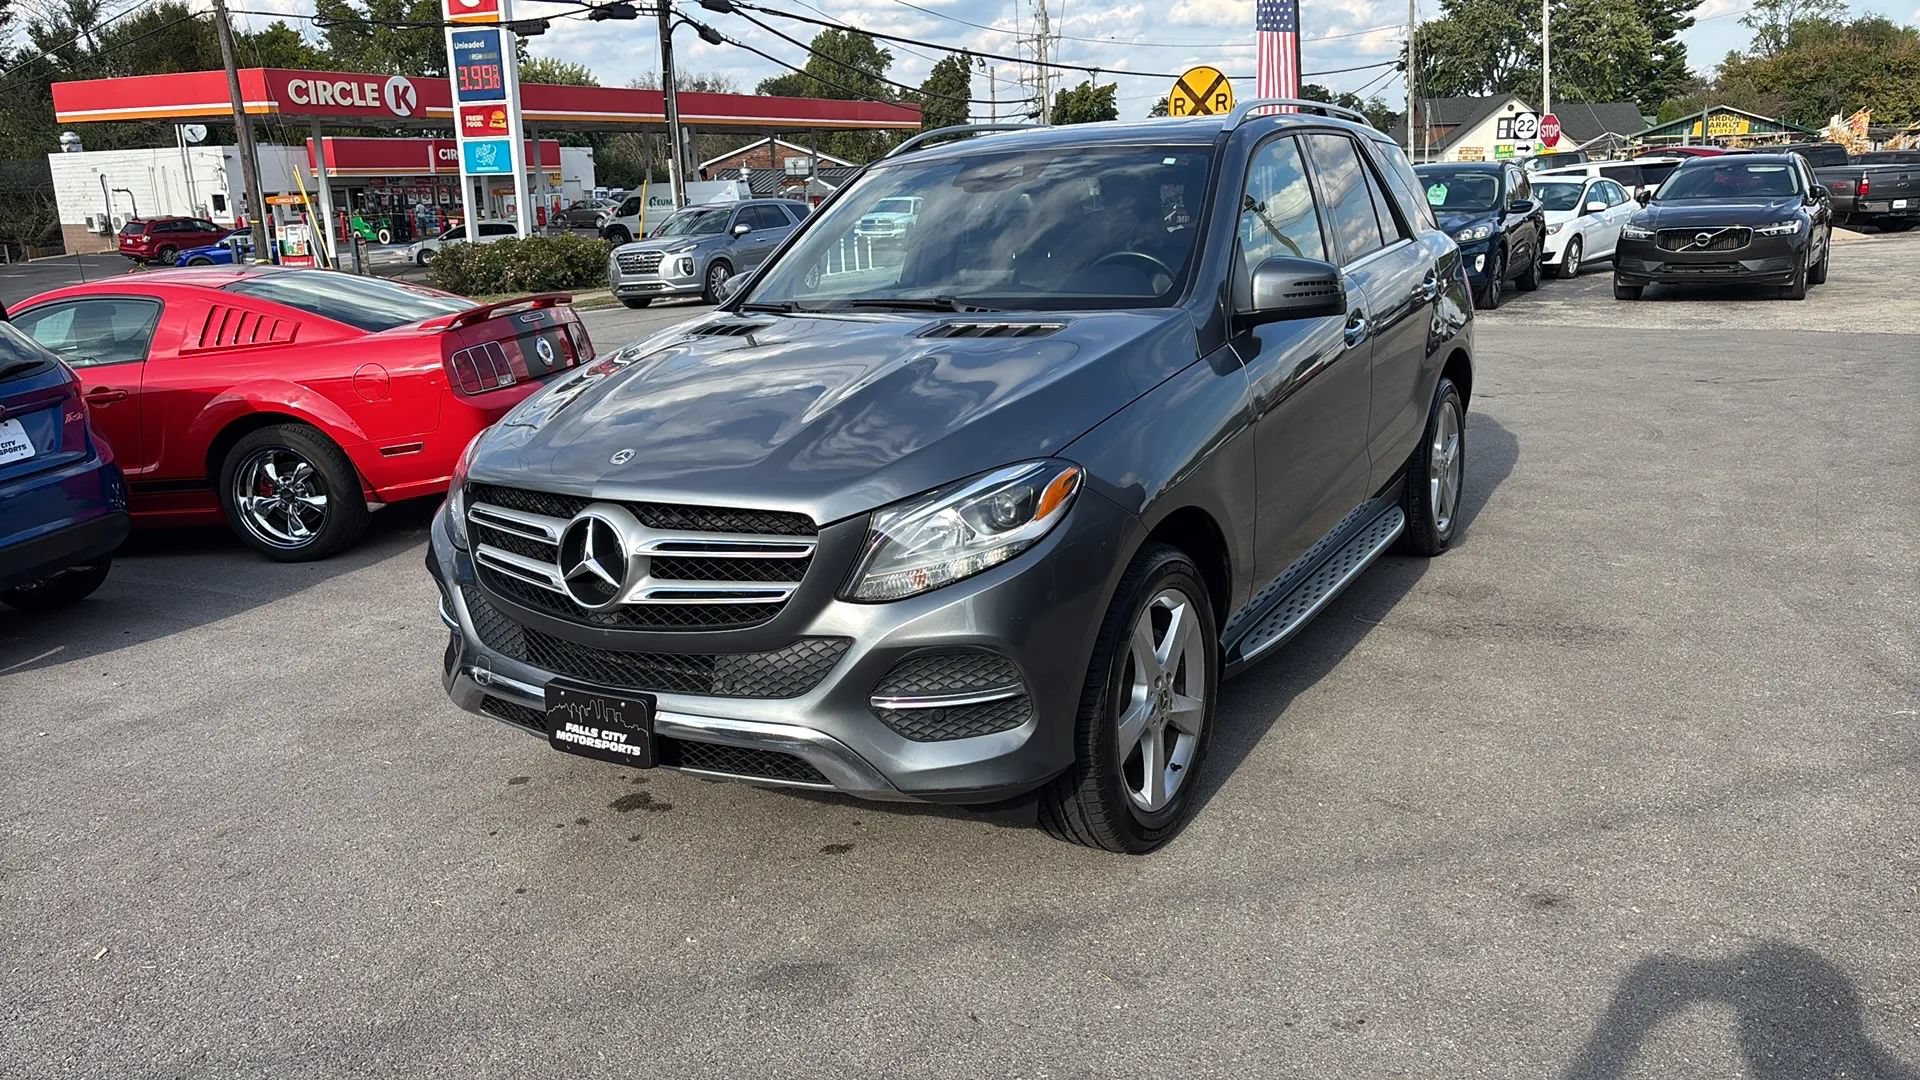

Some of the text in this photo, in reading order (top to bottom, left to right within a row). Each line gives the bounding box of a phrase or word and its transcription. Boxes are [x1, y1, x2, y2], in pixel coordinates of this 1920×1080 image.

[454, 40, 485, 50] Unleaded
[287, 79, 416, 115] CIRCLE K
[1174, 97, 1186, 115] R
[1215, 93, 1228, 111] R
[1517, 120, 1535, 132] 22
[1541, 124, 1559, 138] STOP
[0, 440, 16, 449] CITY
[565, 722, 628, 743] FALLS CITY
[556, 730, 641, 756] MOTORSPORTS
